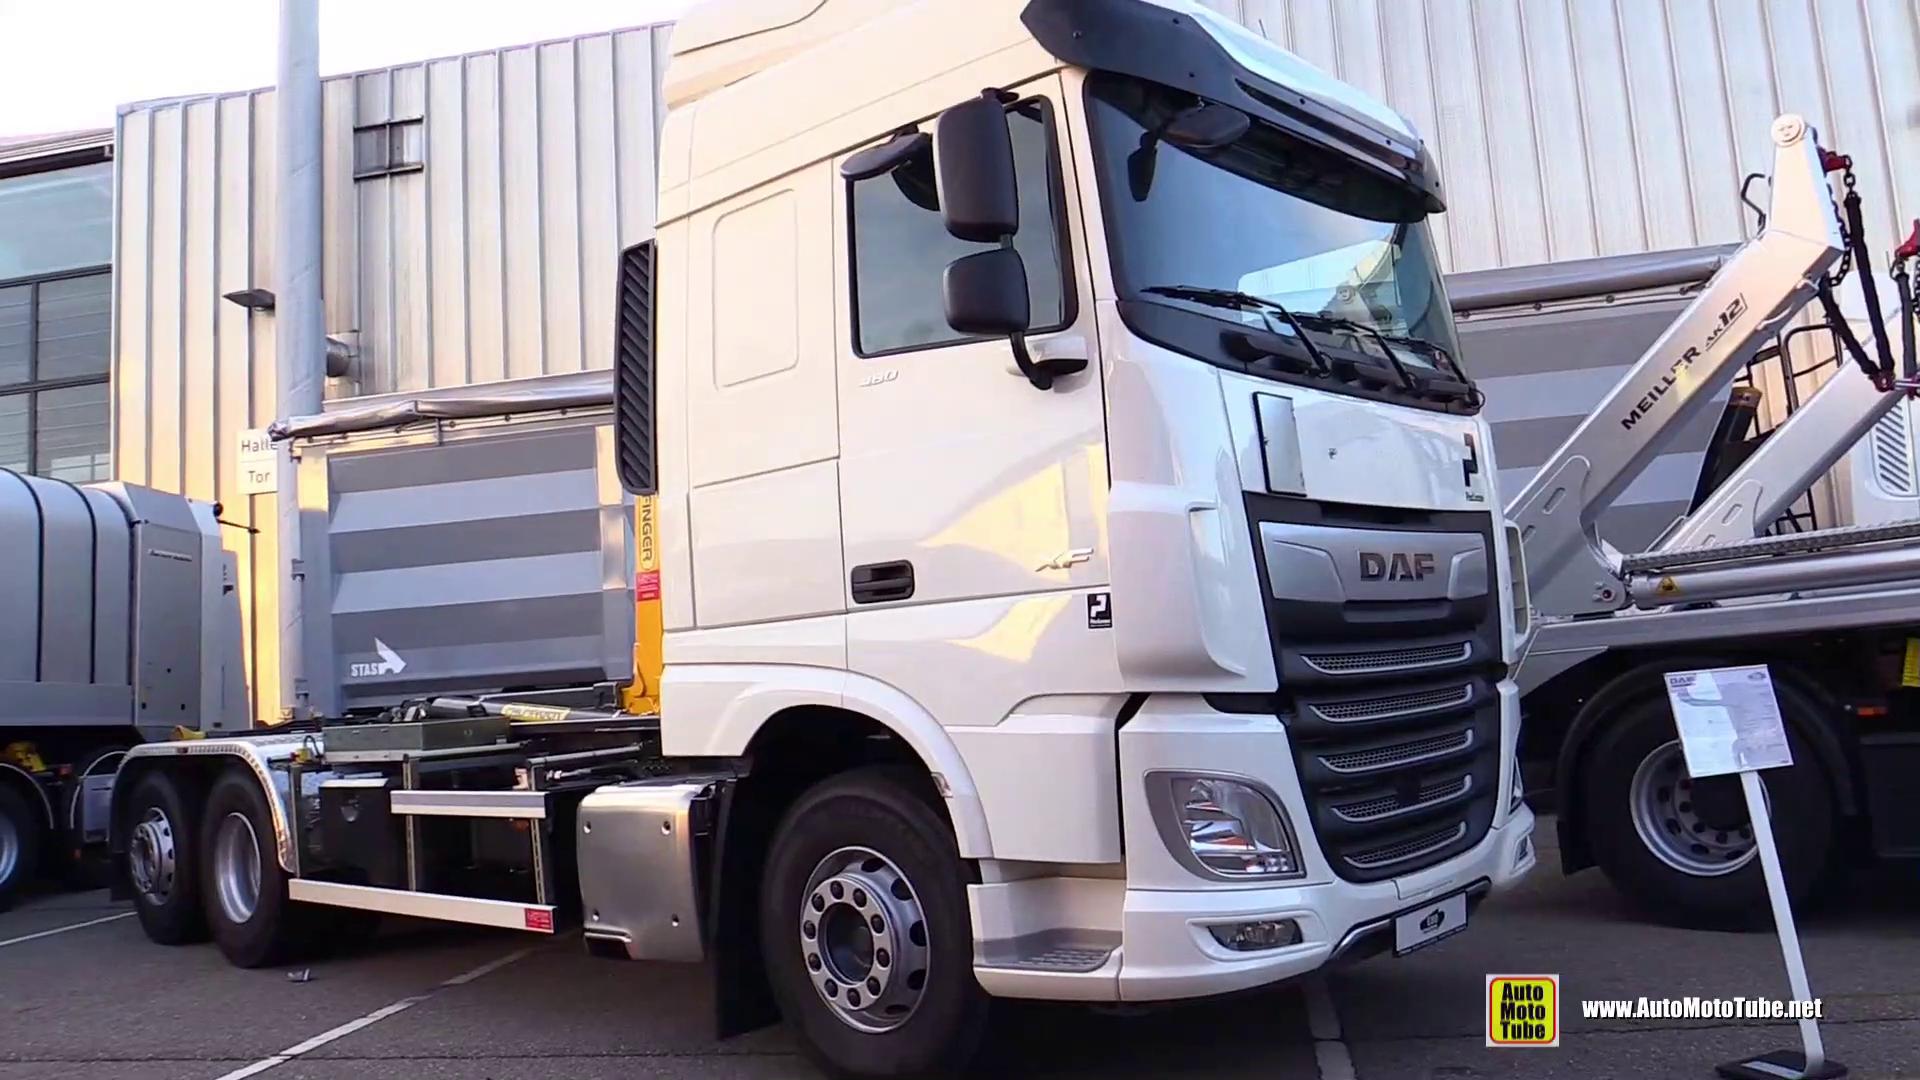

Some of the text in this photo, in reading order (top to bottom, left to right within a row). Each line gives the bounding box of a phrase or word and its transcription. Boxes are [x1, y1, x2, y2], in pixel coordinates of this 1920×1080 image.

[1620, 298, 1743, 431] MEILLER AK12
[248, 470, 271, 483] Tor
[1035, 547, 1095, 572] XF
[1360, 552, 1435, 581] DAF
[351, 662, 378, 677] STAS
